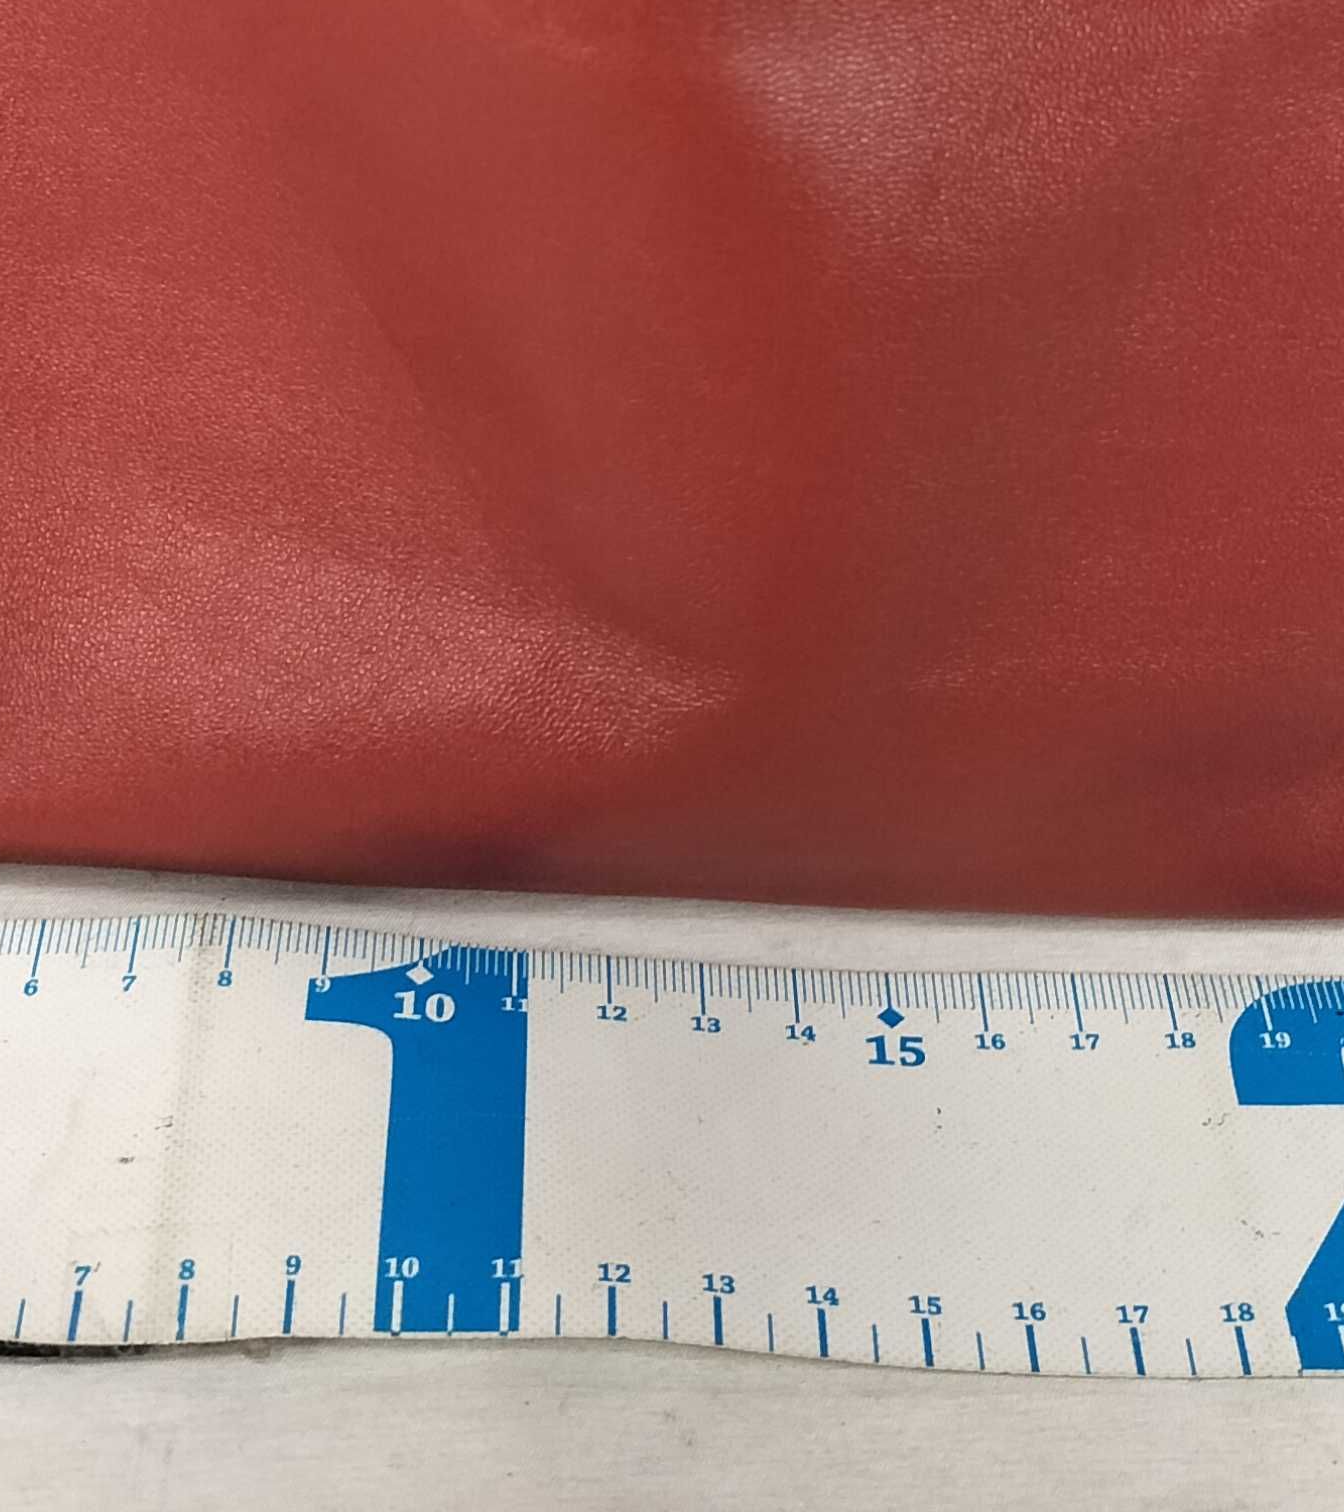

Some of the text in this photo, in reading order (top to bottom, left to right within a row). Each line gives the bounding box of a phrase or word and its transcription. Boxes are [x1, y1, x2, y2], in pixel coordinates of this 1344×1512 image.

[23, 979, 39, 997] 6
[121, 975, 137, 992] 7
[217, 970, 233, 987] 8
[314, 975, 331, 993] 9
[392, 990, 456, 1023] 10
[501, 997, 529, 1013] 11
[595, 1005, 628, 1022] 12
[690, 1016, 722, 1034] 13
[785, 1024, 816, 1042] 14
[865, 1036, 927, 1067] 15
[974, 1033, 1007, 1050] 16
[1068, 1033, 1101, 1051] 17
[1163, 1031, 1197, 1049] 18
[1259, 1031, 1292, 1049] 19
[304, 945, 530, 1333] 1
[73, 1265, 93, 1285] 7
[177, 1258, 196, 1280] 8
[284, 1254, 302, 1276] 9
[383, 1257, 420, 1279] 10
[491, 1257, 523, 1279] 11
[596, 1263, 632, 1283] 12
[701, 1273, 737, 1294] 13
[805, 1286, 840, 1306] 14
[908, 1295, 942, 1316] 15
[1011, 1302, 1047, 1322] 16
[1115, 1304, 1150, 1326] 17
[1219, 1303, 1255, 1323] 18
